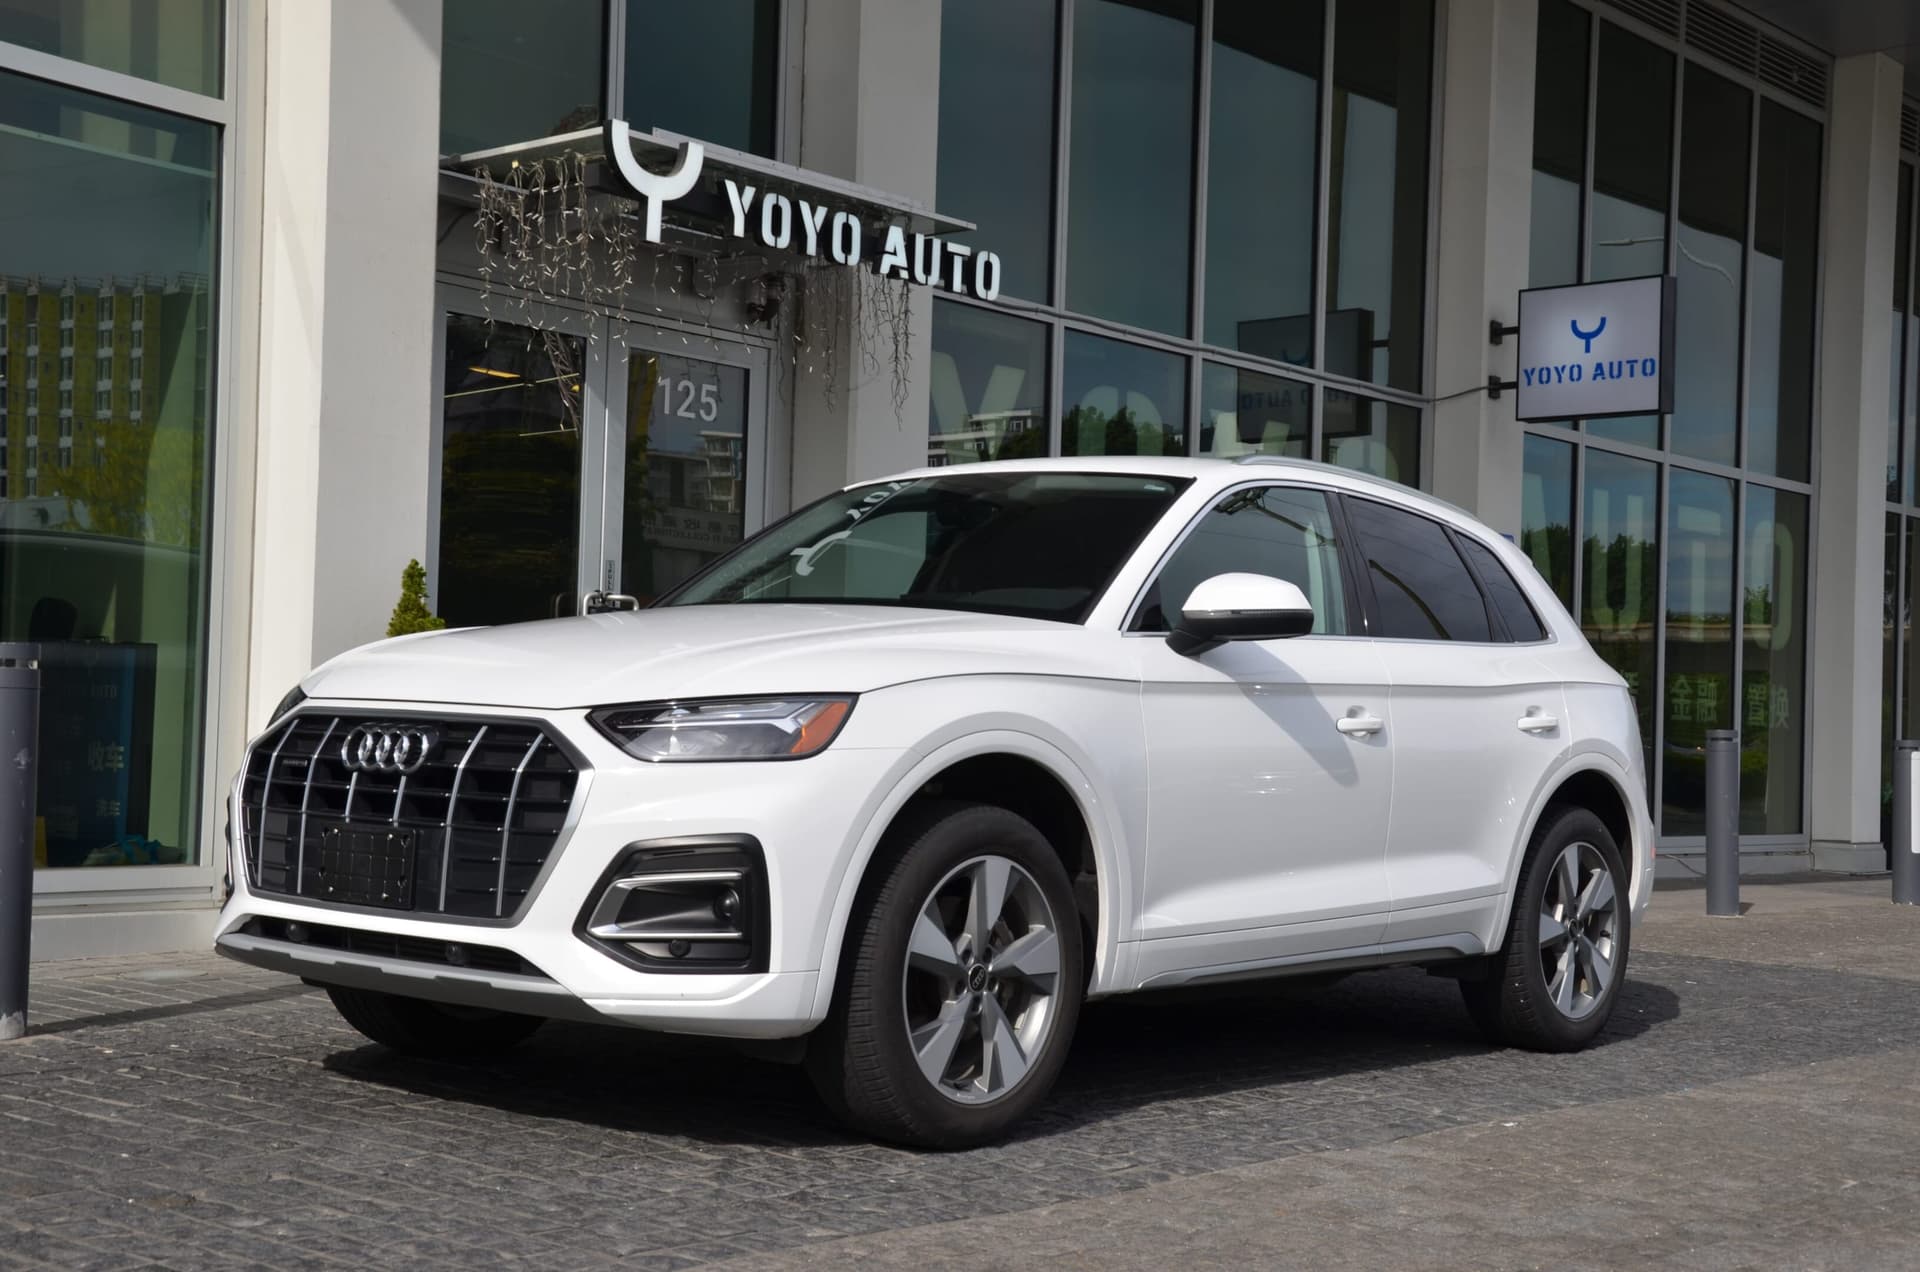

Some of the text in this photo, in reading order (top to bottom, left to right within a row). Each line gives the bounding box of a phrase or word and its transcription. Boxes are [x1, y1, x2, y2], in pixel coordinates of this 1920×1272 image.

[724, 179, 1001, 300] YOYO AUTO
[1523, 357, 1657, 387] YOYO AUTO
[658, 377, 718, 421] 125
